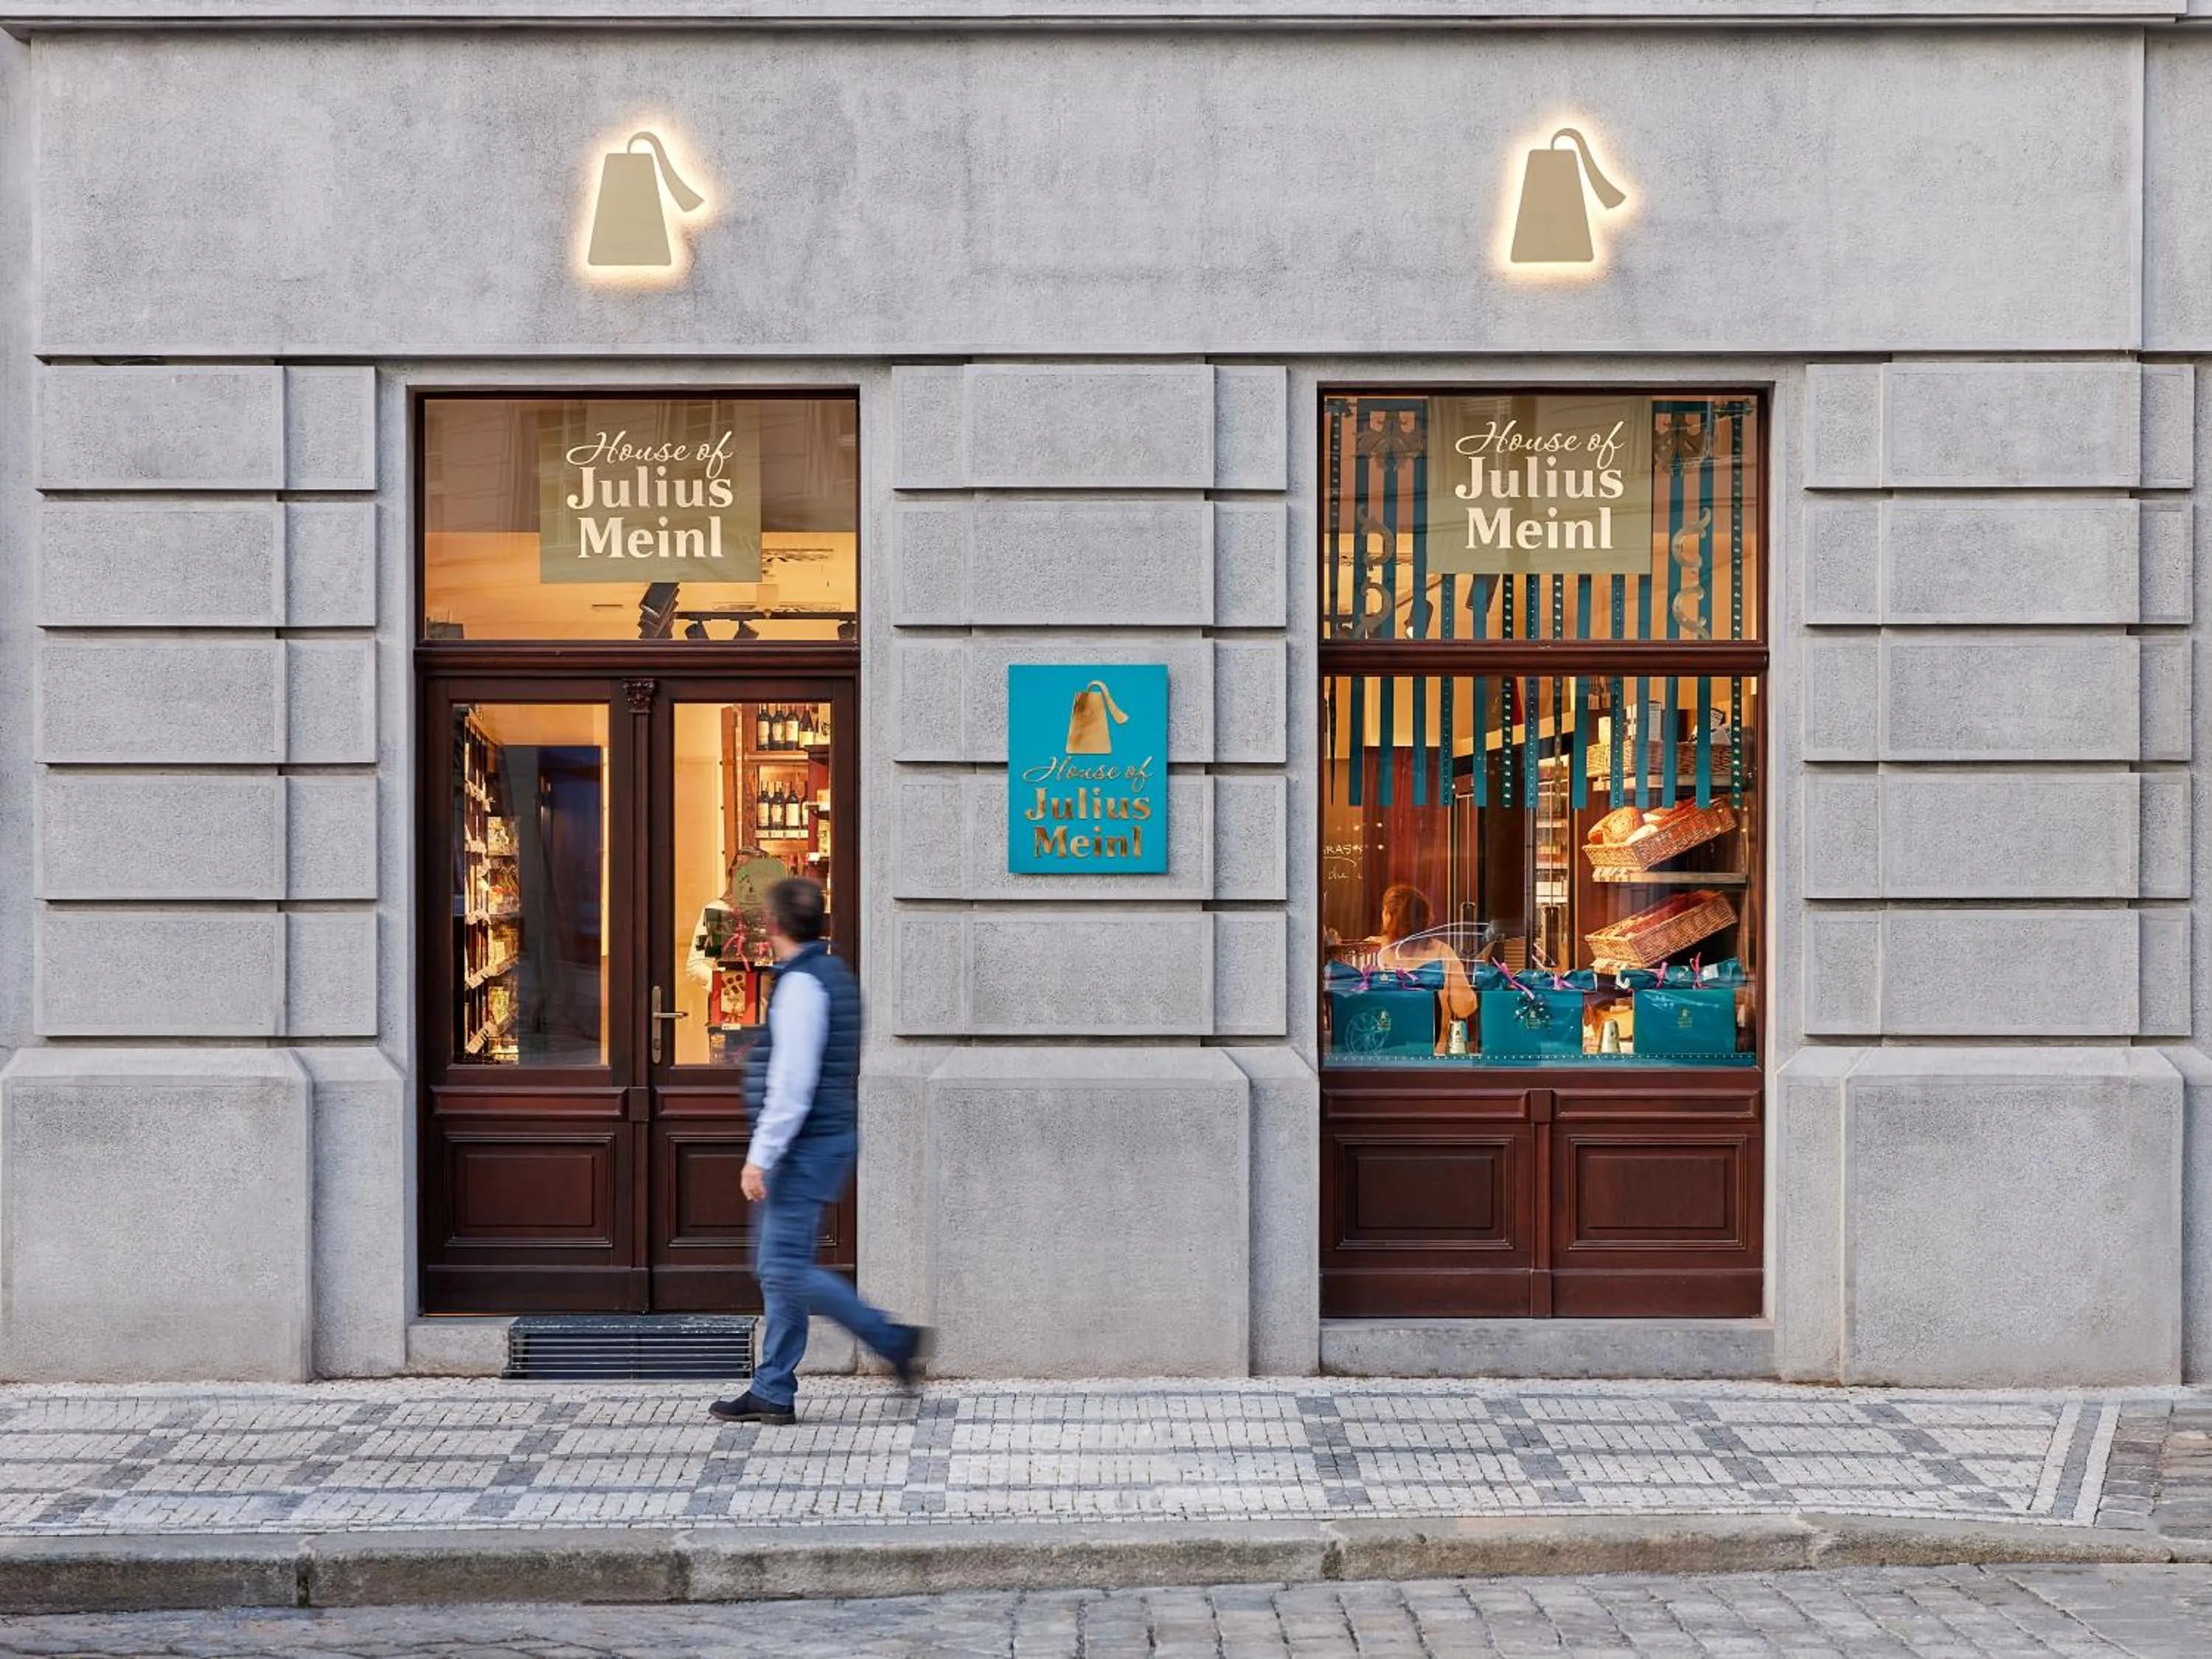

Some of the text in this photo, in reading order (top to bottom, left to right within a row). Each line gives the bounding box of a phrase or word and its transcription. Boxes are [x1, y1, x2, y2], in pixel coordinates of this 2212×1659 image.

[566, 430, 734, 479] House of
[1455, 420, 1626, 470] House of
[566, 466, 734, 509] Julius
[1455, 456, 1624, 499] Julius
[577, 516, 723, 558] Meinl
[1465, 507, 1613, 549] Meinl
[1023, 756, 1155, 793] House of
[1026, 787, 1152, 820] Julius
[1034, 825, 1143, 858] Meinl
